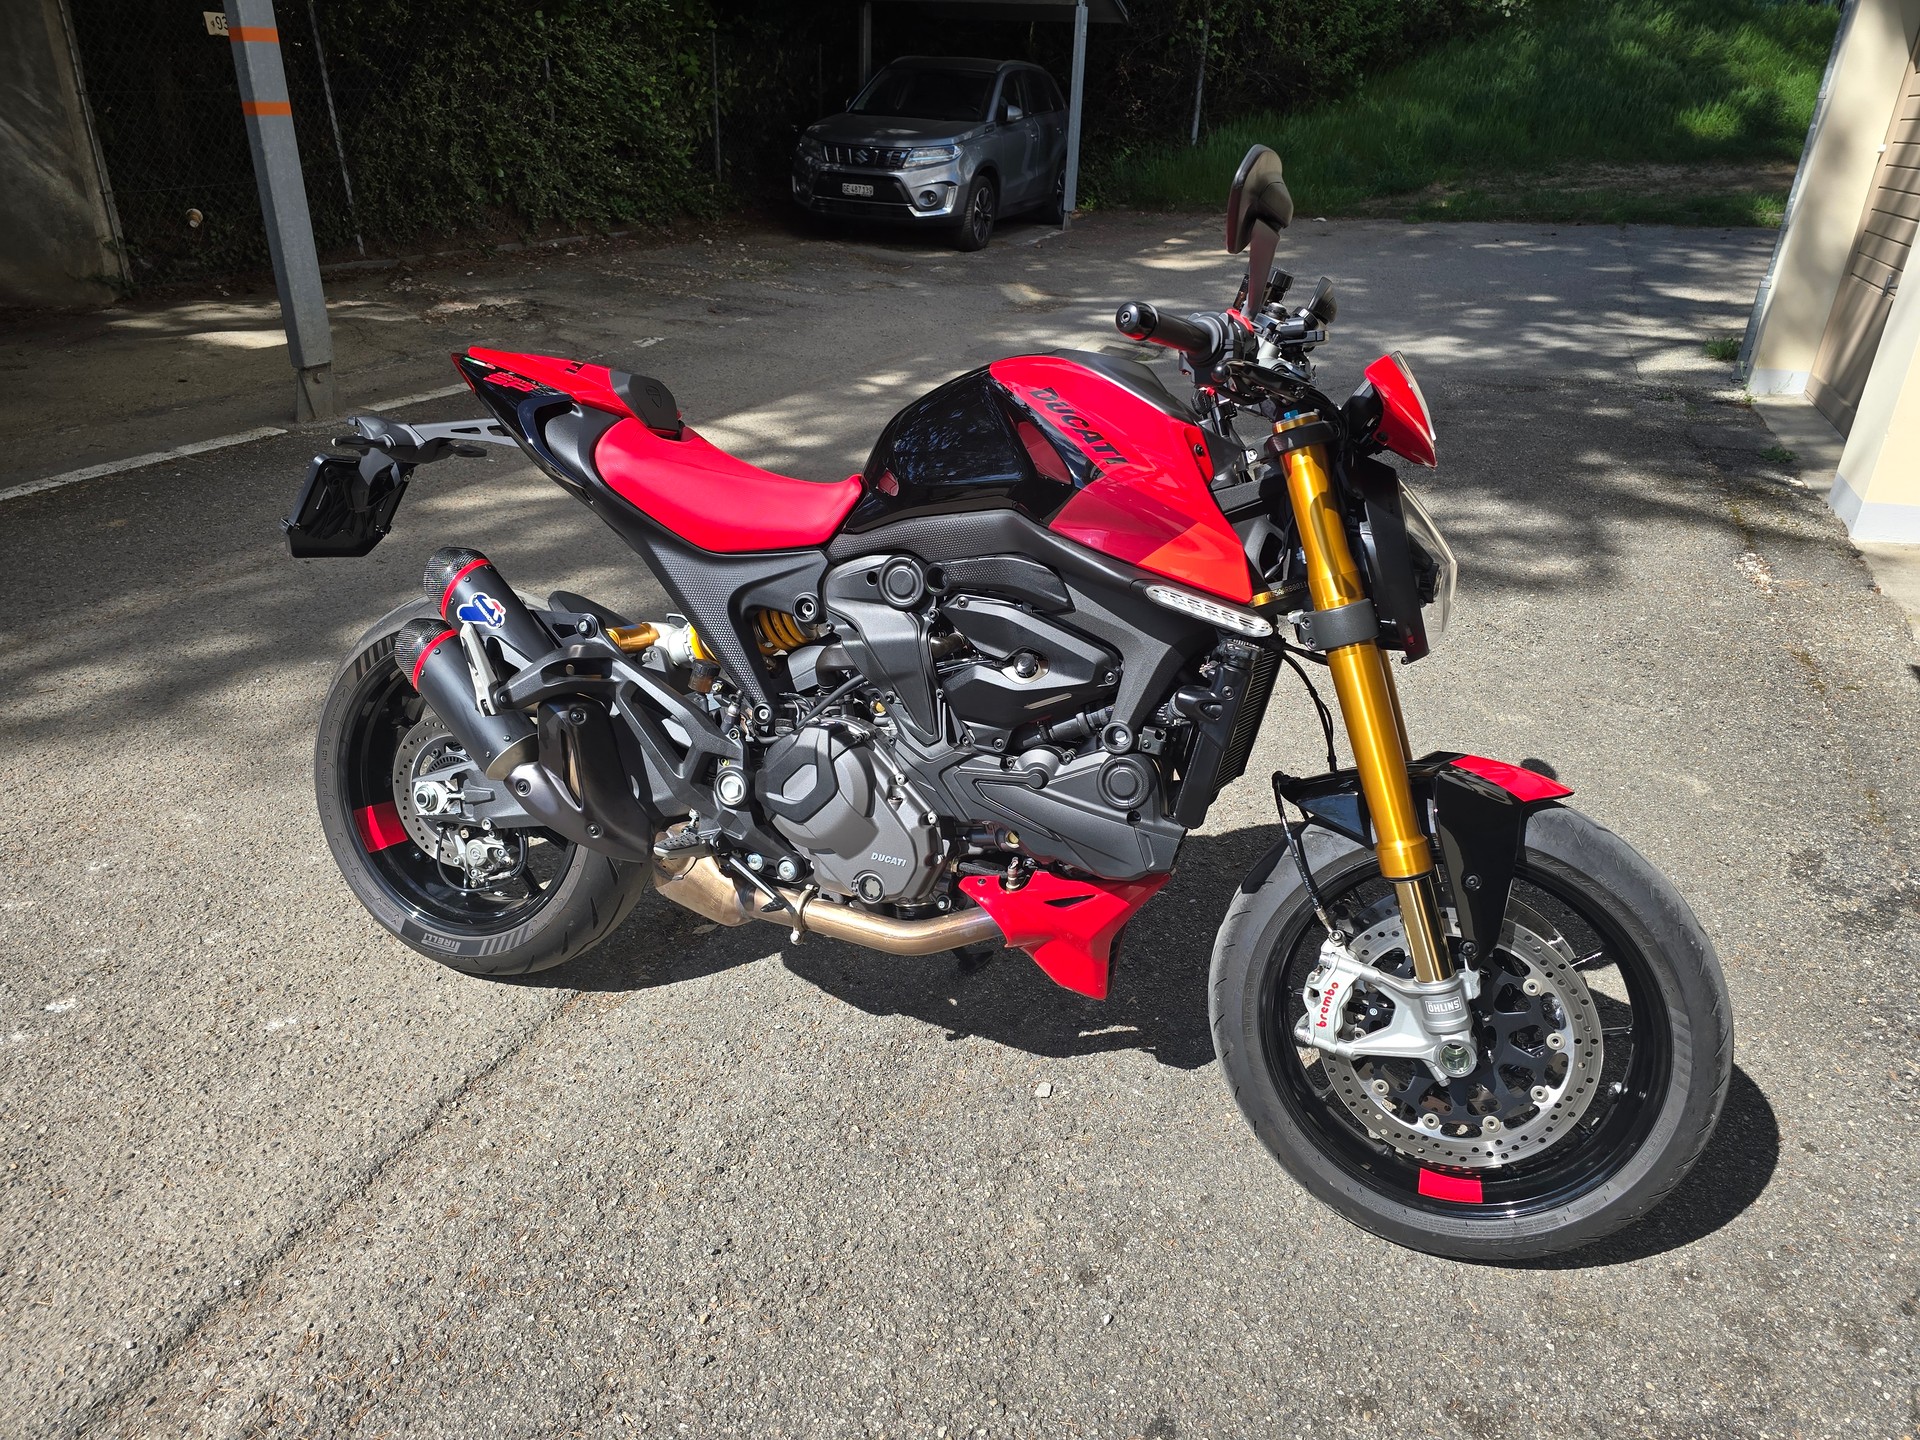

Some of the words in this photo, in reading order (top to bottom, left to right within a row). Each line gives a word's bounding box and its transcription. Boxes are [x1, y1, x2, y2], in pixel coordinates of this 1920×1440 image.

[1030, 387, 1128, 464] DUCATI
[871, 852, 907, 867] DUCATI
[421, 932, 461, 953] PIRELLI
[1316, 982, 1339, 1028] brembo
[1428, 1000, 1460, 1013] ÖHLINS
